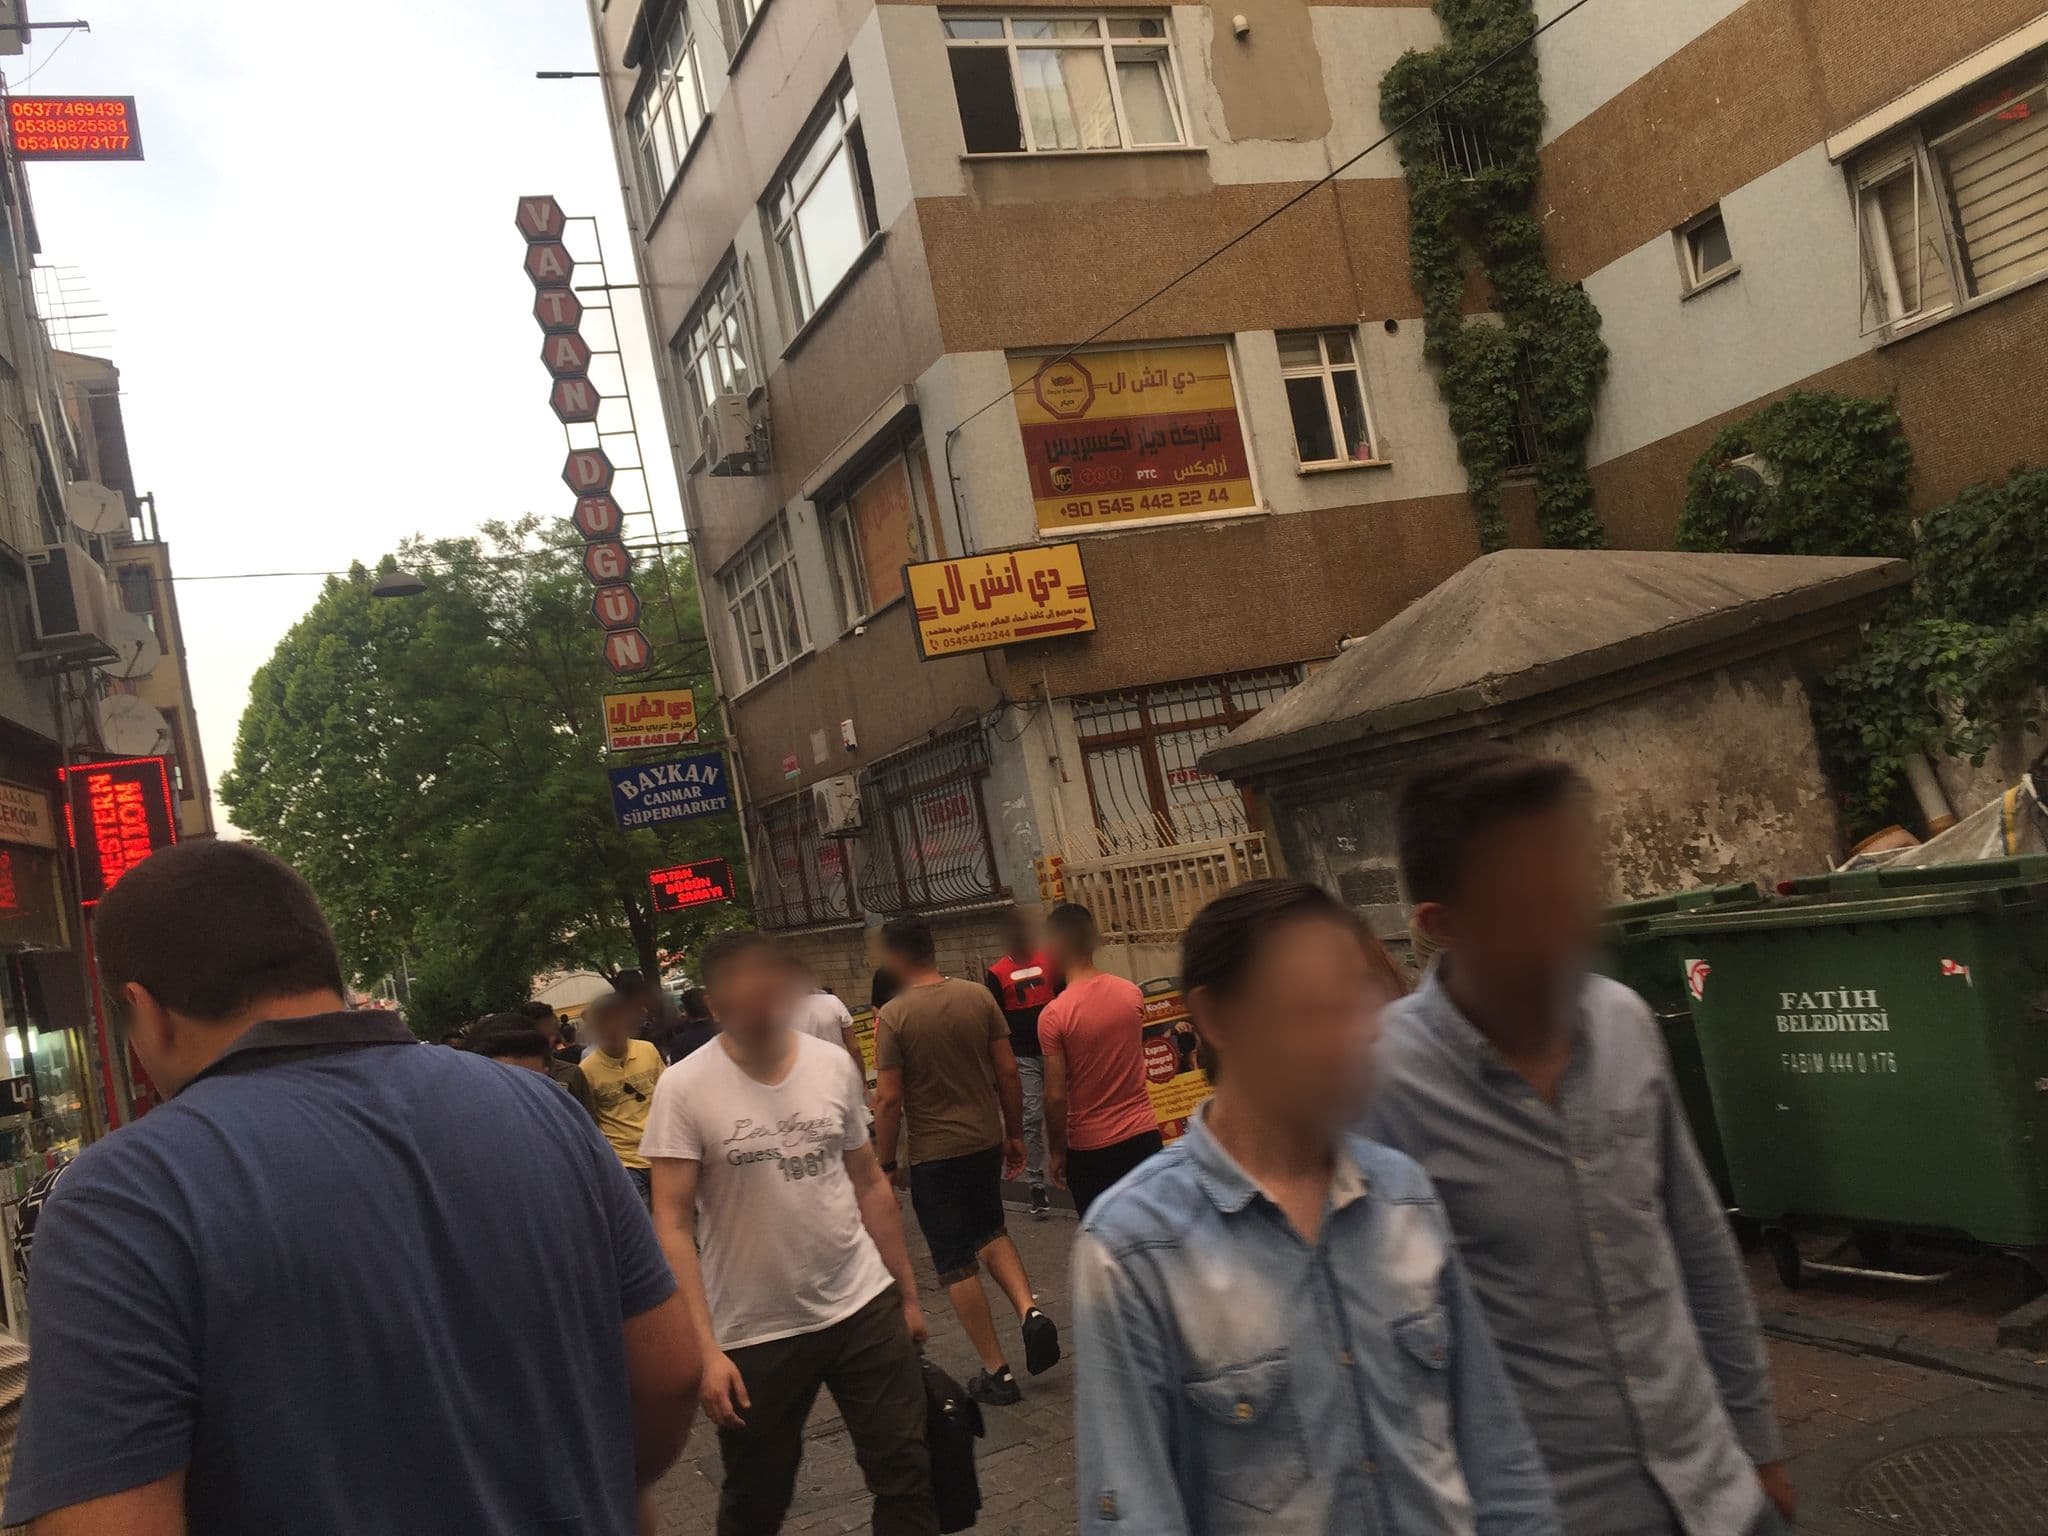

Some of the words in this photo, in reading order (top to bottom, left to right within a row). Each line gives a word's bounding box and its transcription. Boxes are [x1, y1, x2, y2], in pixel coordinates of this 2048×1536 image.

[12, 102, 126, 117] 05377469439
[15, 119, 128, 133] 05389825581
[18, 135, 130, 150] 05340373177
[1107, 372, 1126, 395] ال
[1172, 370, 1197, 394] دي
[526, 203, 588, 412] VATAN
[575, 455, 641, 667] DÜĞÜN
[1138, 428, 1167, 457] ديار
[1169, 416, 1222, 451] شركة
[1173, 456, 1227, 481] أرامكس
[1060, 502, 1094, 518] +90
[1099, 498, 1134, 515] 545
[1140, 493, 1175, 511] 442
[1178, 490, 1203, 506] 22
[1208, 487, 1230, 503] 44
[937, 563, 966, 616] ال
[1027, 568, 1061, 608] دي
[943, 629, 1011, 648] 05454422244
[612, 722, 645, 733] معتمد
[646, 723, 668, 732] عربي
[670, 721, 693, 730] مركز
[617, 764, 719, 800] BAYKAN
[643, 785, 702, 806] CANMAR
[623, 797, 727, 826] SÜPERMARKET
[1779, 985, 1880, 1010] FATİH
[1776, 1008, 1889, 1032] BELEDİYESİ
[1829, 1052, 1854, 1073] 444
[1857, 1052, 1867, 1073] 0
[1871, 1052, 1897, 1073] 176
